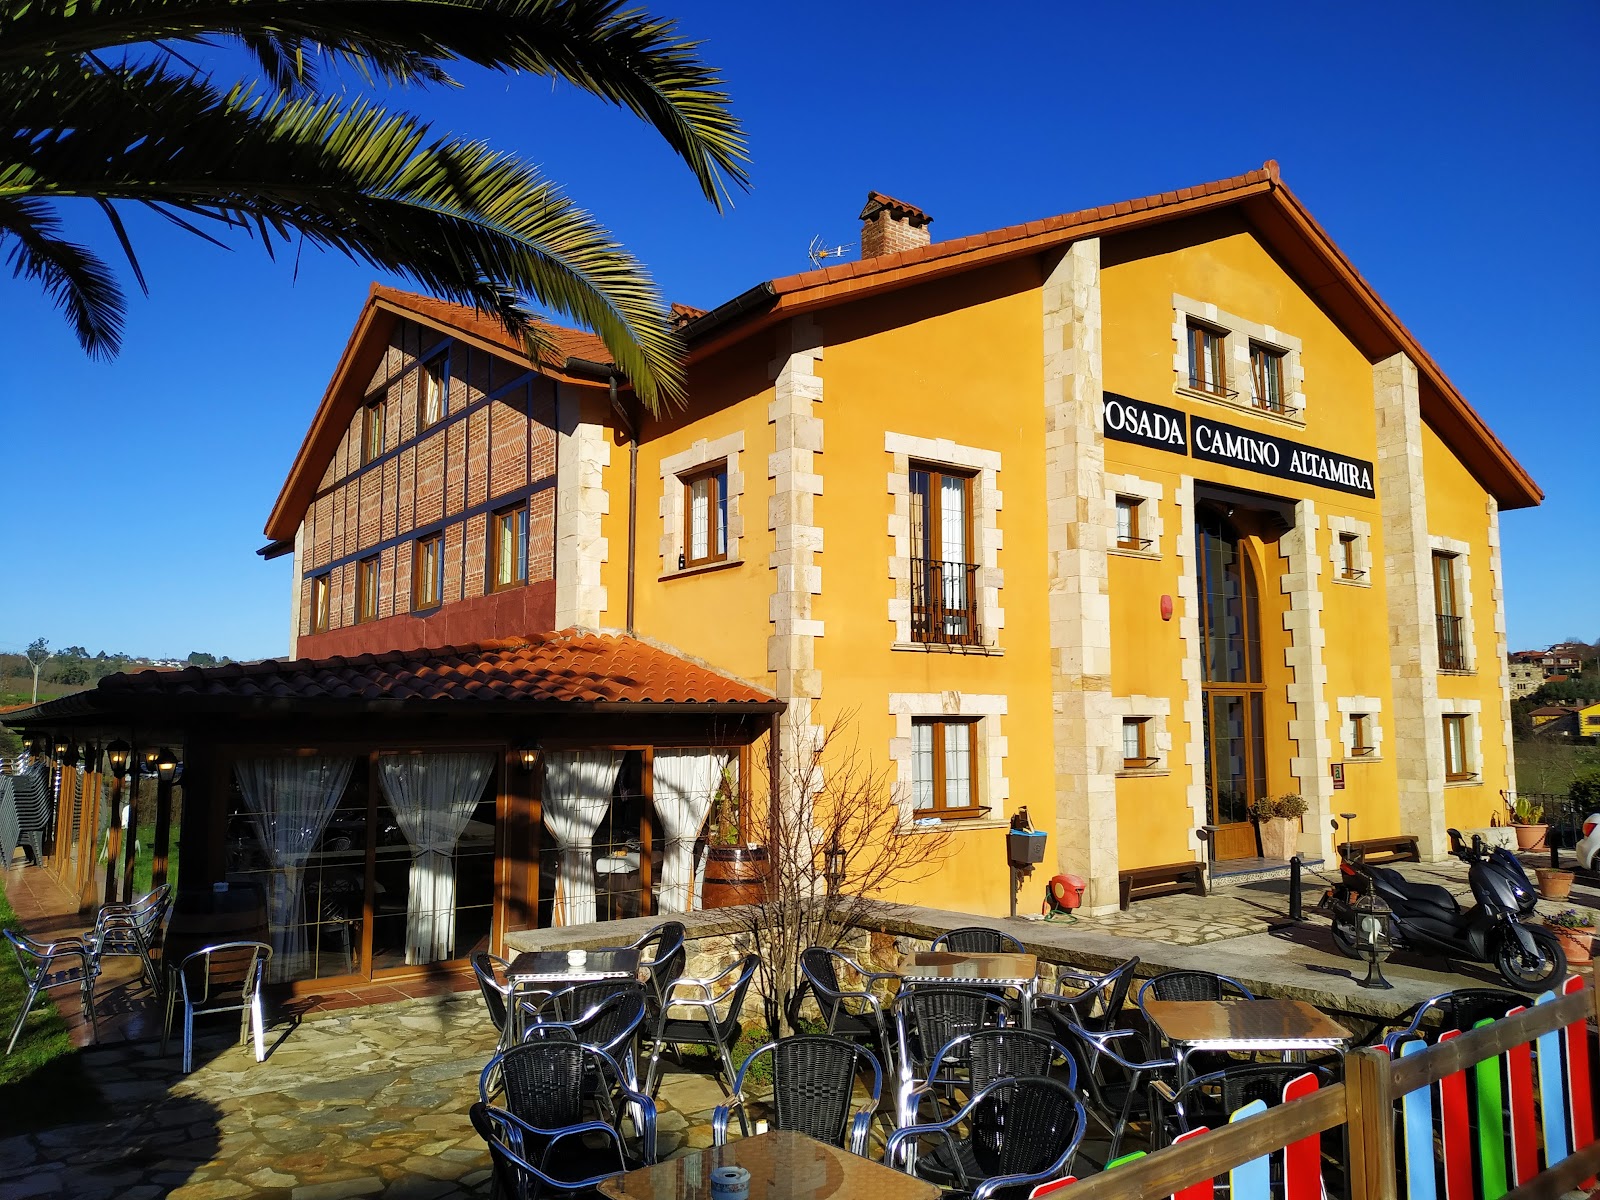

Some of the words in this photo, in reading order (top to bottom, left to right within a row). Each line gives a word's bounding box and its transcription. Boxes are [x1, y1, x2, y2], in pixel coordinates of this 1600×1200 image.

[1103, 401, 1185, 445] OSADA
[1195, 425, 1280, 468] CAMINO
[1289, 449, 1373, 490] ALTAMIRA
